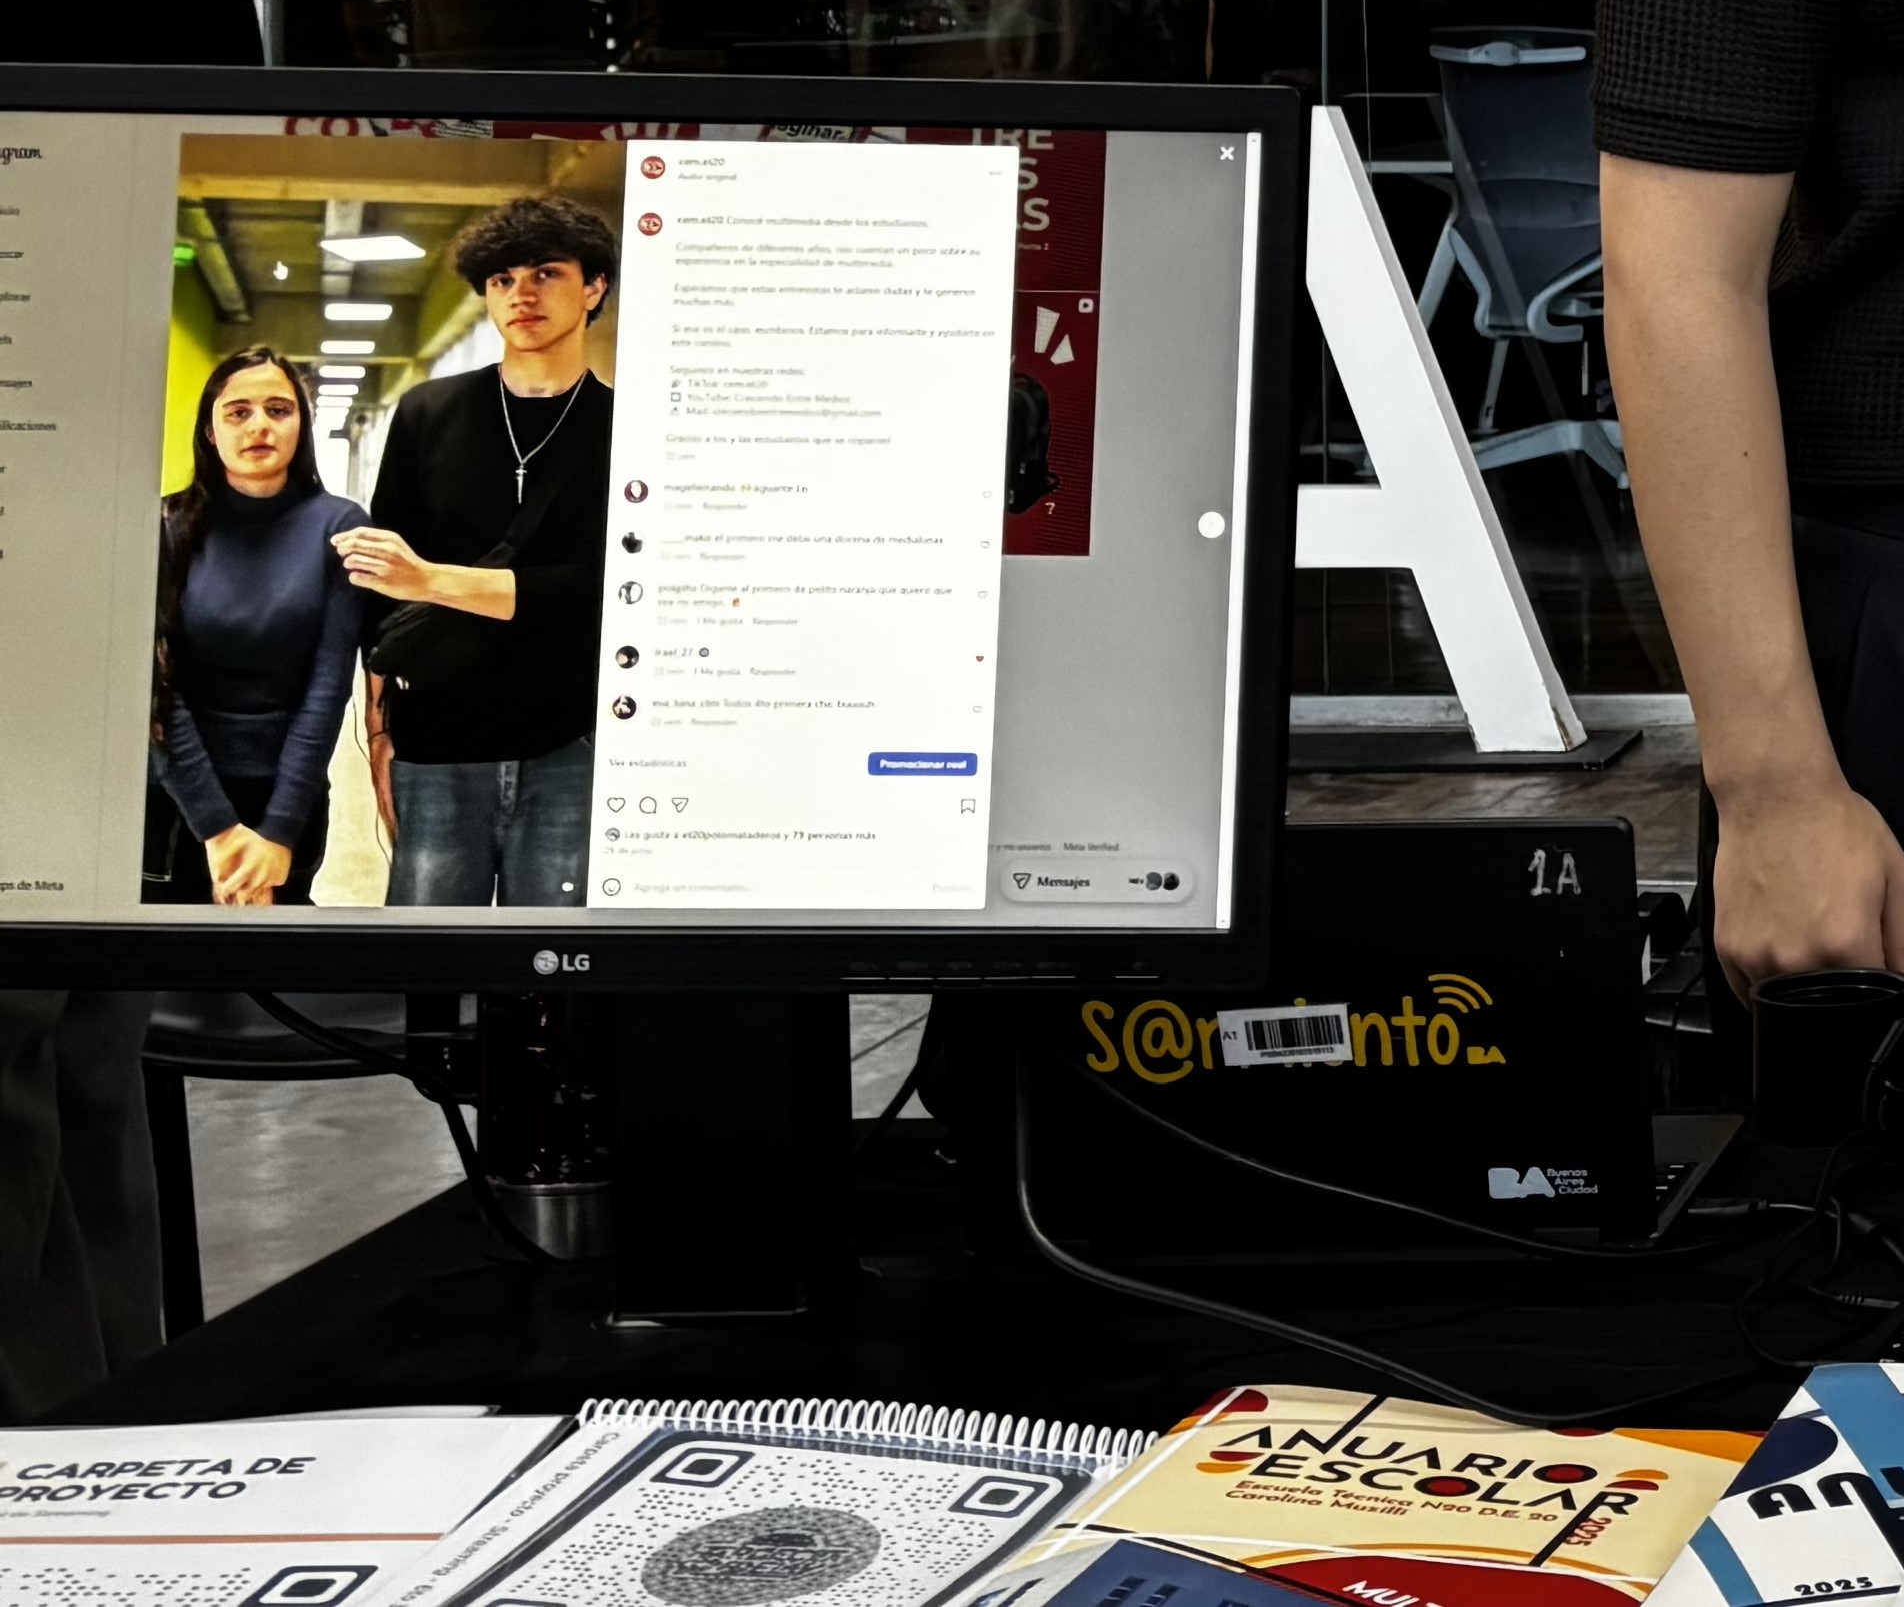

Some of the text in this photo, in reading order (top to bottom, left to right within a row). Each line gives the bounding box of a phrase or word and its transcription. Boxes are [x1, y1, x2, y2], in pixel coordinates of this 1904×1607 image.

[1037, 876, 1091, 890] Mensajes
[561, 953, 591, 972] LG
[1081, 996, 1460, 1083] S@rnto
[16, 1456, 317, 1480] CARPETA DE
[1219, 1424, 1598, 1484] ANUARIO
[0, 1481, 248, 1502] PROYECTO
[510, 1471, 570, 1518] proyecto
[1248, 1452, 1639, 1516] ESCOLAR
[1225, 1489, 1408, 1516] Carolina Muzilli
[1235, 1479, 1322, 1497] Escuela
[1332, 1489, 1414, 1508] Técnica
[1527, 1512, 1558, 1523] 20
[1562, 1517, 1612, 1548] 2025
[433, 1524, 510, 1578] Streaming
[1794, 1576, 1873, 1597] 2025
